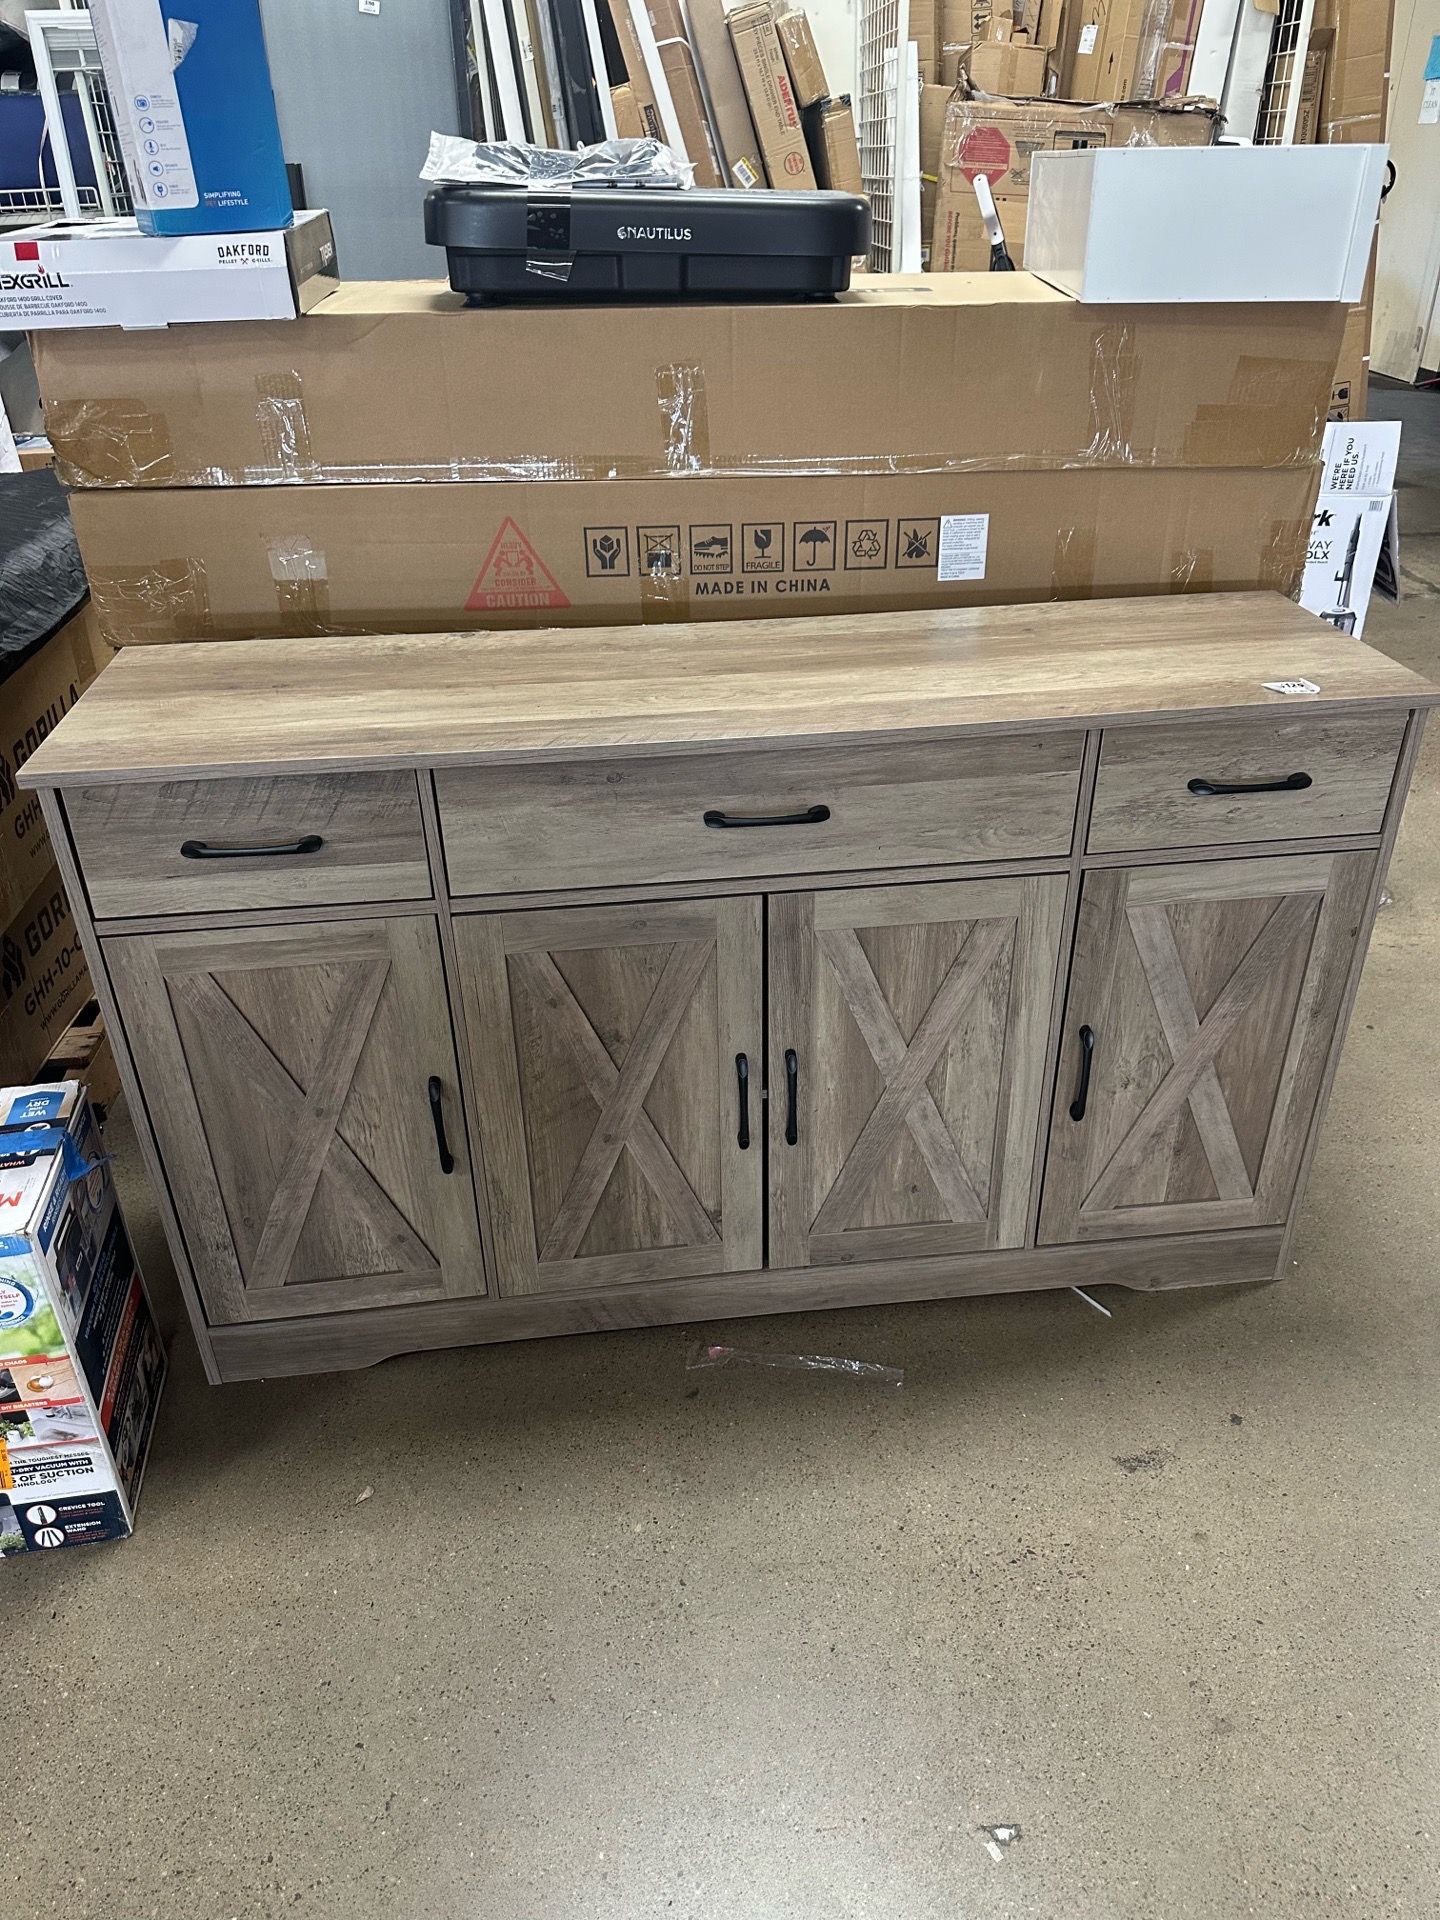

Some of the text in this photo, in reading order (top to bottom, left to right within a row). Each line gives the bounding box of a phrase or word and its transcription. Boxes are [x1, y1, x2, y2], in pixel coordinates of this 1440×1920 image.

[203, 190, 241, 198] SIMPLIFYING
[217, 198, 249, 207] LIFESTYLE
[627, 226, 692, 240] NAUTILUS
[217, 244, 270, 258] OAKFORD
[1338, 437, 1355, 490] HERE IF YOU
[1346, 452, 1360, 490] NEED US.
[1330, 463, 1342, 490] WE'RE
[694, 564, 703, 572] DO
[746, 562, 780, 570] FRAGILE
[695, 578, 831, 595] MADE IN CHINA
[486, 592, 551, 608] CAUTION
[26, 1100, 50, 1108] DRY
[20, 1110, 46, 1118] WET
[28, 1454, 62, 1463] TOUGHEST
[35, 1462, 68, 1472] VACUUM
[20, 1474, 36, 1482] OF
[40, 1466, 94, 1479] SUCTION
[58, 1504, 86, 1512] CREVICE
[64, 1520, 102, 1529] EXTENSION
